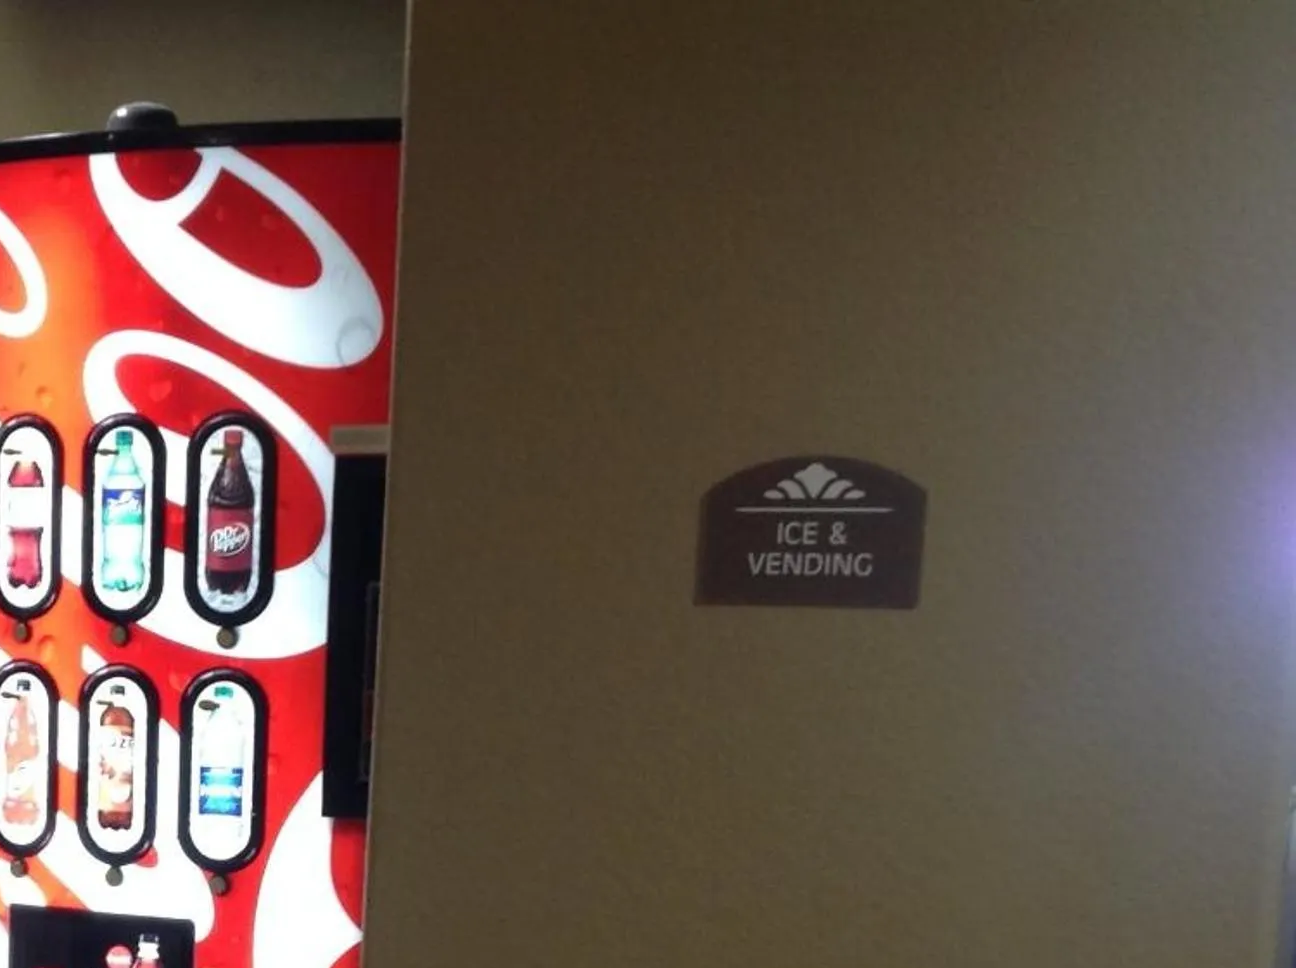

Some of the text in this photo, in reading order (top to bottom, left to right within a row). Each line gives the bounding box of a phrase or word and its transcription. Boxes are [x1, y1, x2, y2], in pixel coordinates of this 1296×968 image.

[777, 521, 848, 545] ICE &
[748, 552, 874, 577] VENDING
